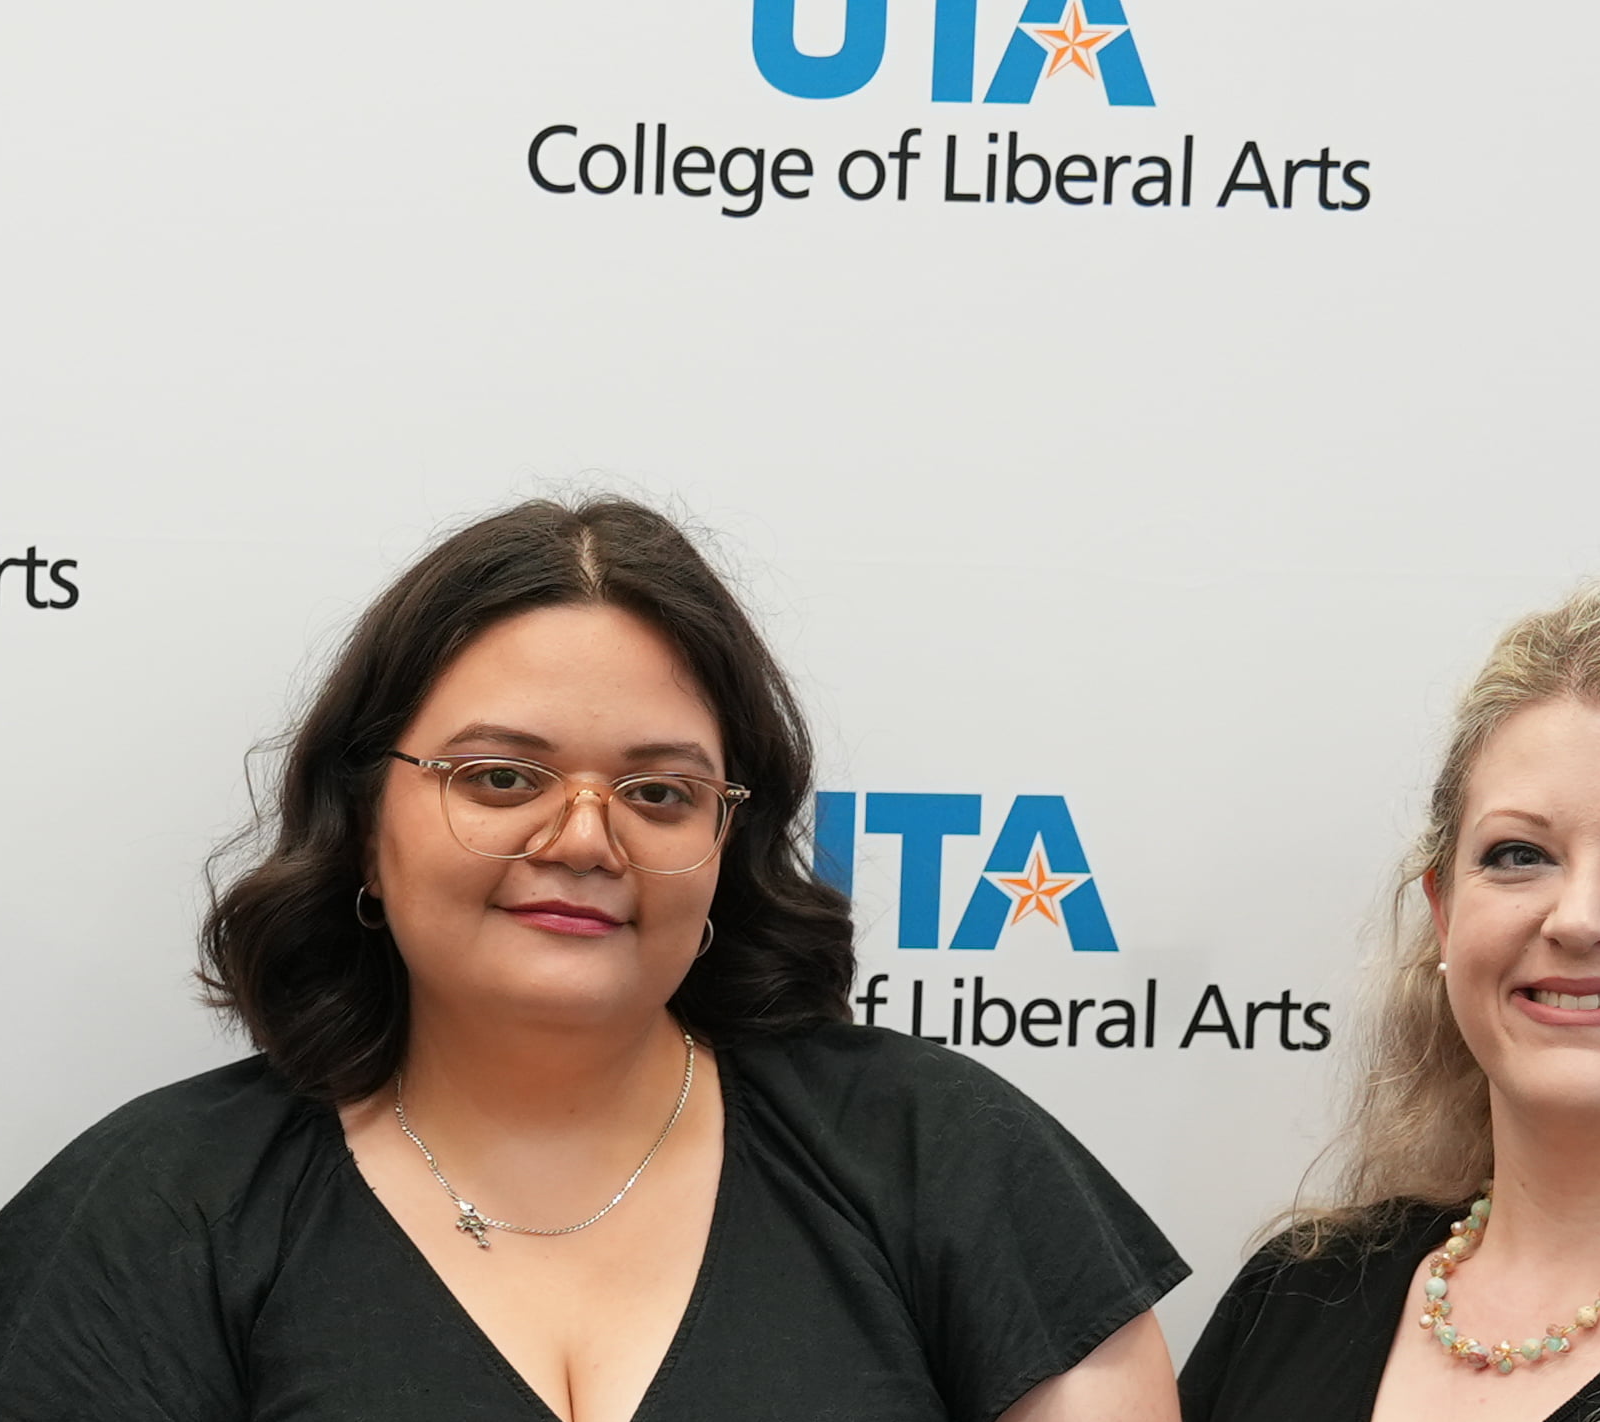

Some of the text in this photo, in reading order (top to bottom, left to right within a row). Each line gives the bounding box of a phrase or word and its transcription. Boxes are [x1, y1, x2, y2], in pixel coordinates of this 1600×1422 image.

[527, 123, 1371, 218] College of Liberal Arts
[912, 976, 1157, 1049] Liberal
[1179, 983, 1332, 1052] Arts
